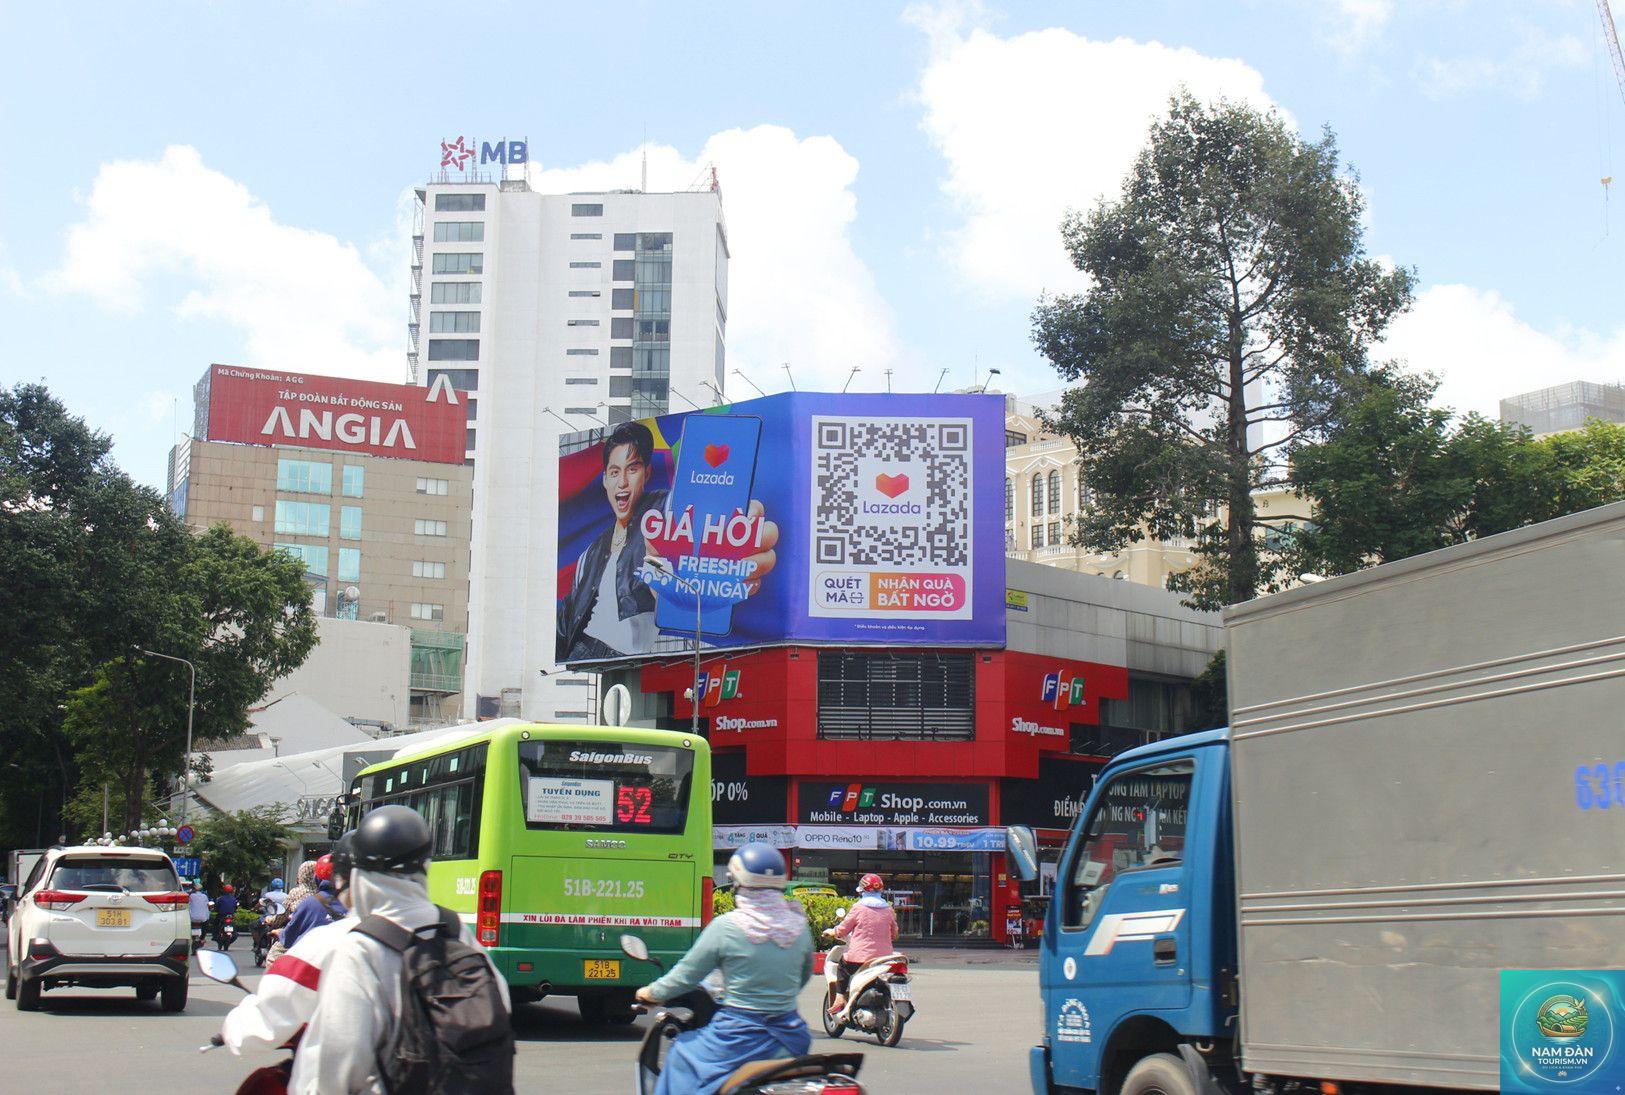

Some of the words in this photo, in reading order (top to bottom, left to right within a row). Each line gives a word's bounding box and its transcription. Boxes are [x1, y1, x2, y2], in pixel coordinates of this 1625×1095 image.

[480, 141, 527, 164] MB
[286, 376, 304, 384] AGG
[279, 389, 298, 401] TẬP
[300, 391, 328, 404] ĐOÀN
[331, 393, 348, 406] BẤT
[351, 396, 380, 410] ĐỘNG
[690, 471, 734, 486] Lazada
[864, 501, 921, 514] Lazada
[640, 504, 694, 543] GIÁ
[702, 507, 765, 548] HỜI
[678, 555, 758, 577] FREESHIP
[825, 576, 861, 590] QUÉT
[878, 576, 920, 591] NHẬN
[923, 576, 954, 590] QUÀ
[826, 590, 848, 603] MÃ
[878, 591, 910, 606] BẤT
[914, 591, 954, 607] NGỜ
[1043, 674, 1085, 704] FPT
[716, 716, 778, 732] Shop.com.vn
[1012, 717, 1064, 736] Shop.com.vn
[569, 750, 653, 765] SaigonBus
[728, 782, 748, 801] 0%
[829, 788, 874, 806] FPT
[1151, 782, 1186, 799] LAPTOP
[296, 798, 337, 818] SAIGO
[617, 785, 652, 824] 52
[1054, 795, 1078, 817] ĐIỂM
[810, 812, 842, 822] Mobile
[854, 812, 884, 824] Laptop
[894, 813, 918, 824] Apple
[928, 813, 978, 824] Accessories
[805, 834, 831, 842] OPPO
[832, 834, 862, 843] Reno10
[917, 836, 957, 848] 10.99
[564, 879, 644, 898] 51B-221.25
[589, 968, 616, 977] 221.25
[594, 960, 610, 969] 51B
